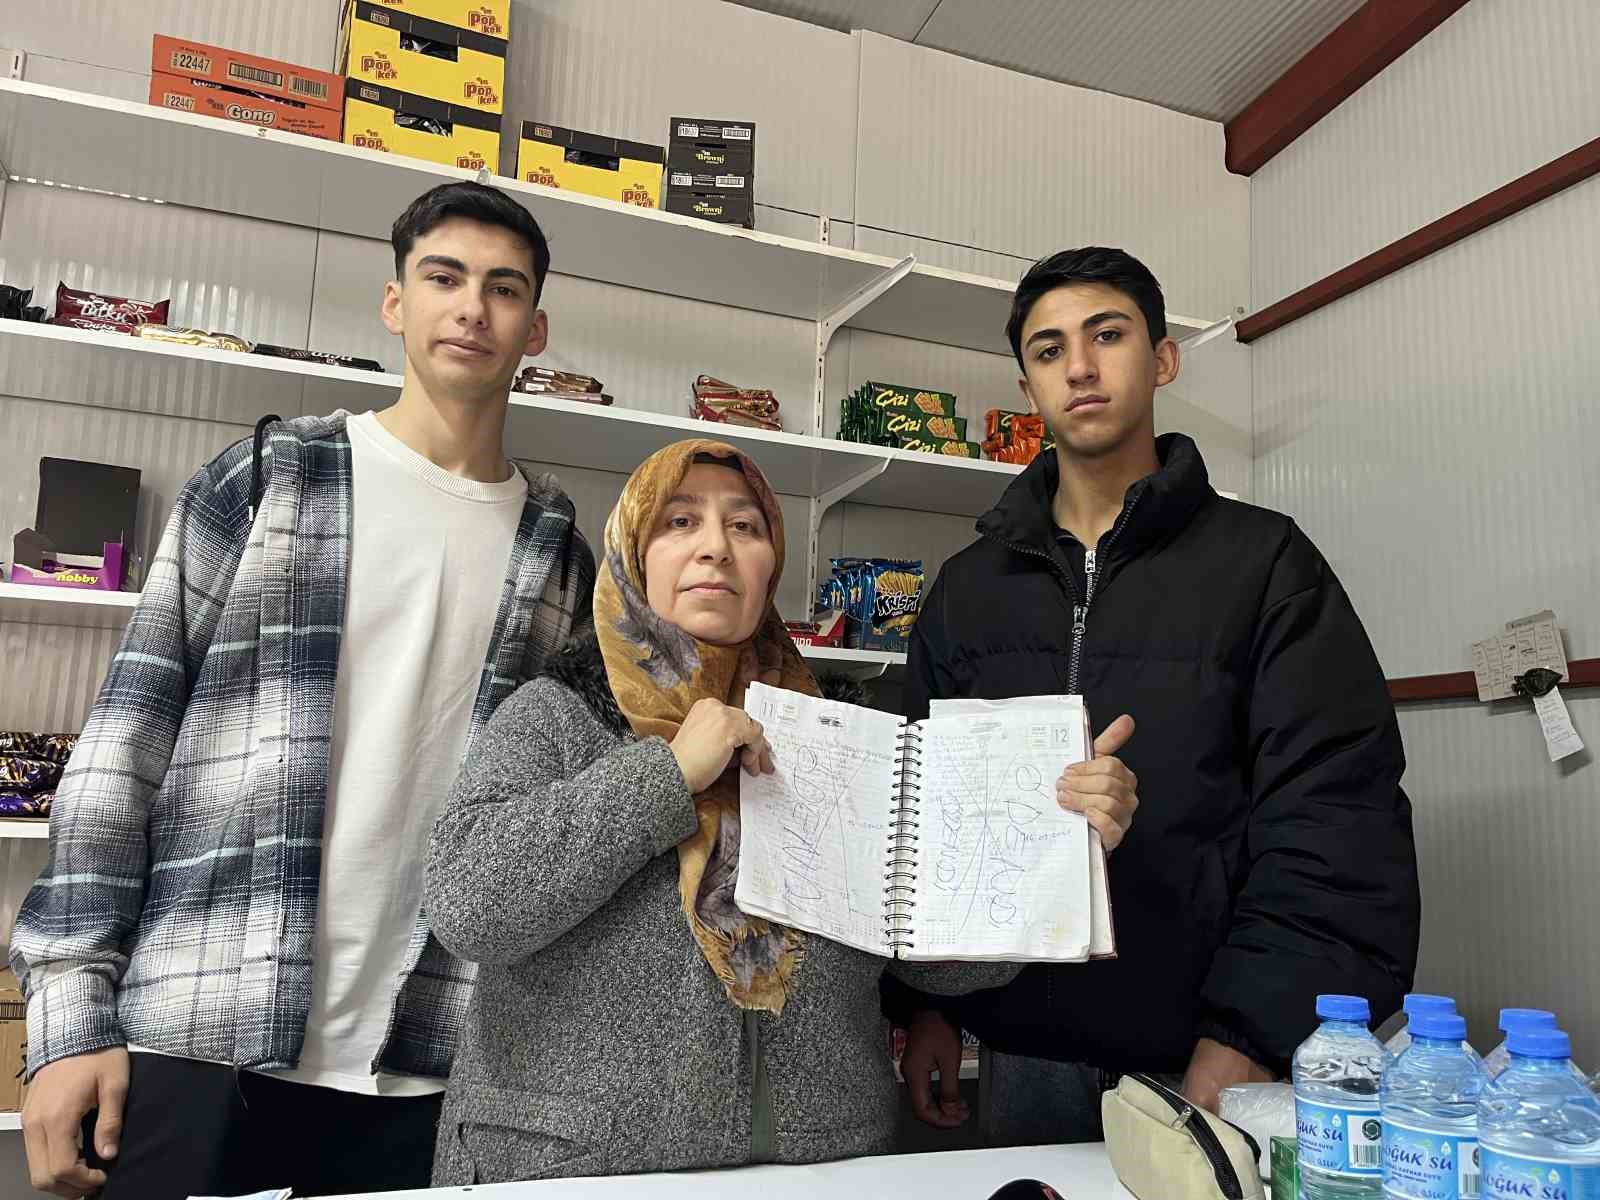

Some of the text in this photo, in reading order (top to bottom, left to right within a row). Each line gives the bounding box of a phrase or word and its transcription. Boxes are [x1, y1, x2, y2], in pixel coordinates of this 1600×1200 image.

[469, 12, 496, 28] Pop
[179, 54, 210, 73] 22447
[362, 57, 391, 73] Pop
[377, 69, 398, 80] kek
[465, 82, 493, 99] Pop
[227, 104, 275, 124] Gong
[876, 390, 909, 408] Çizi
[887, 415, 922, 433] Çizi
[1055, 728, 1069, 744] 12
